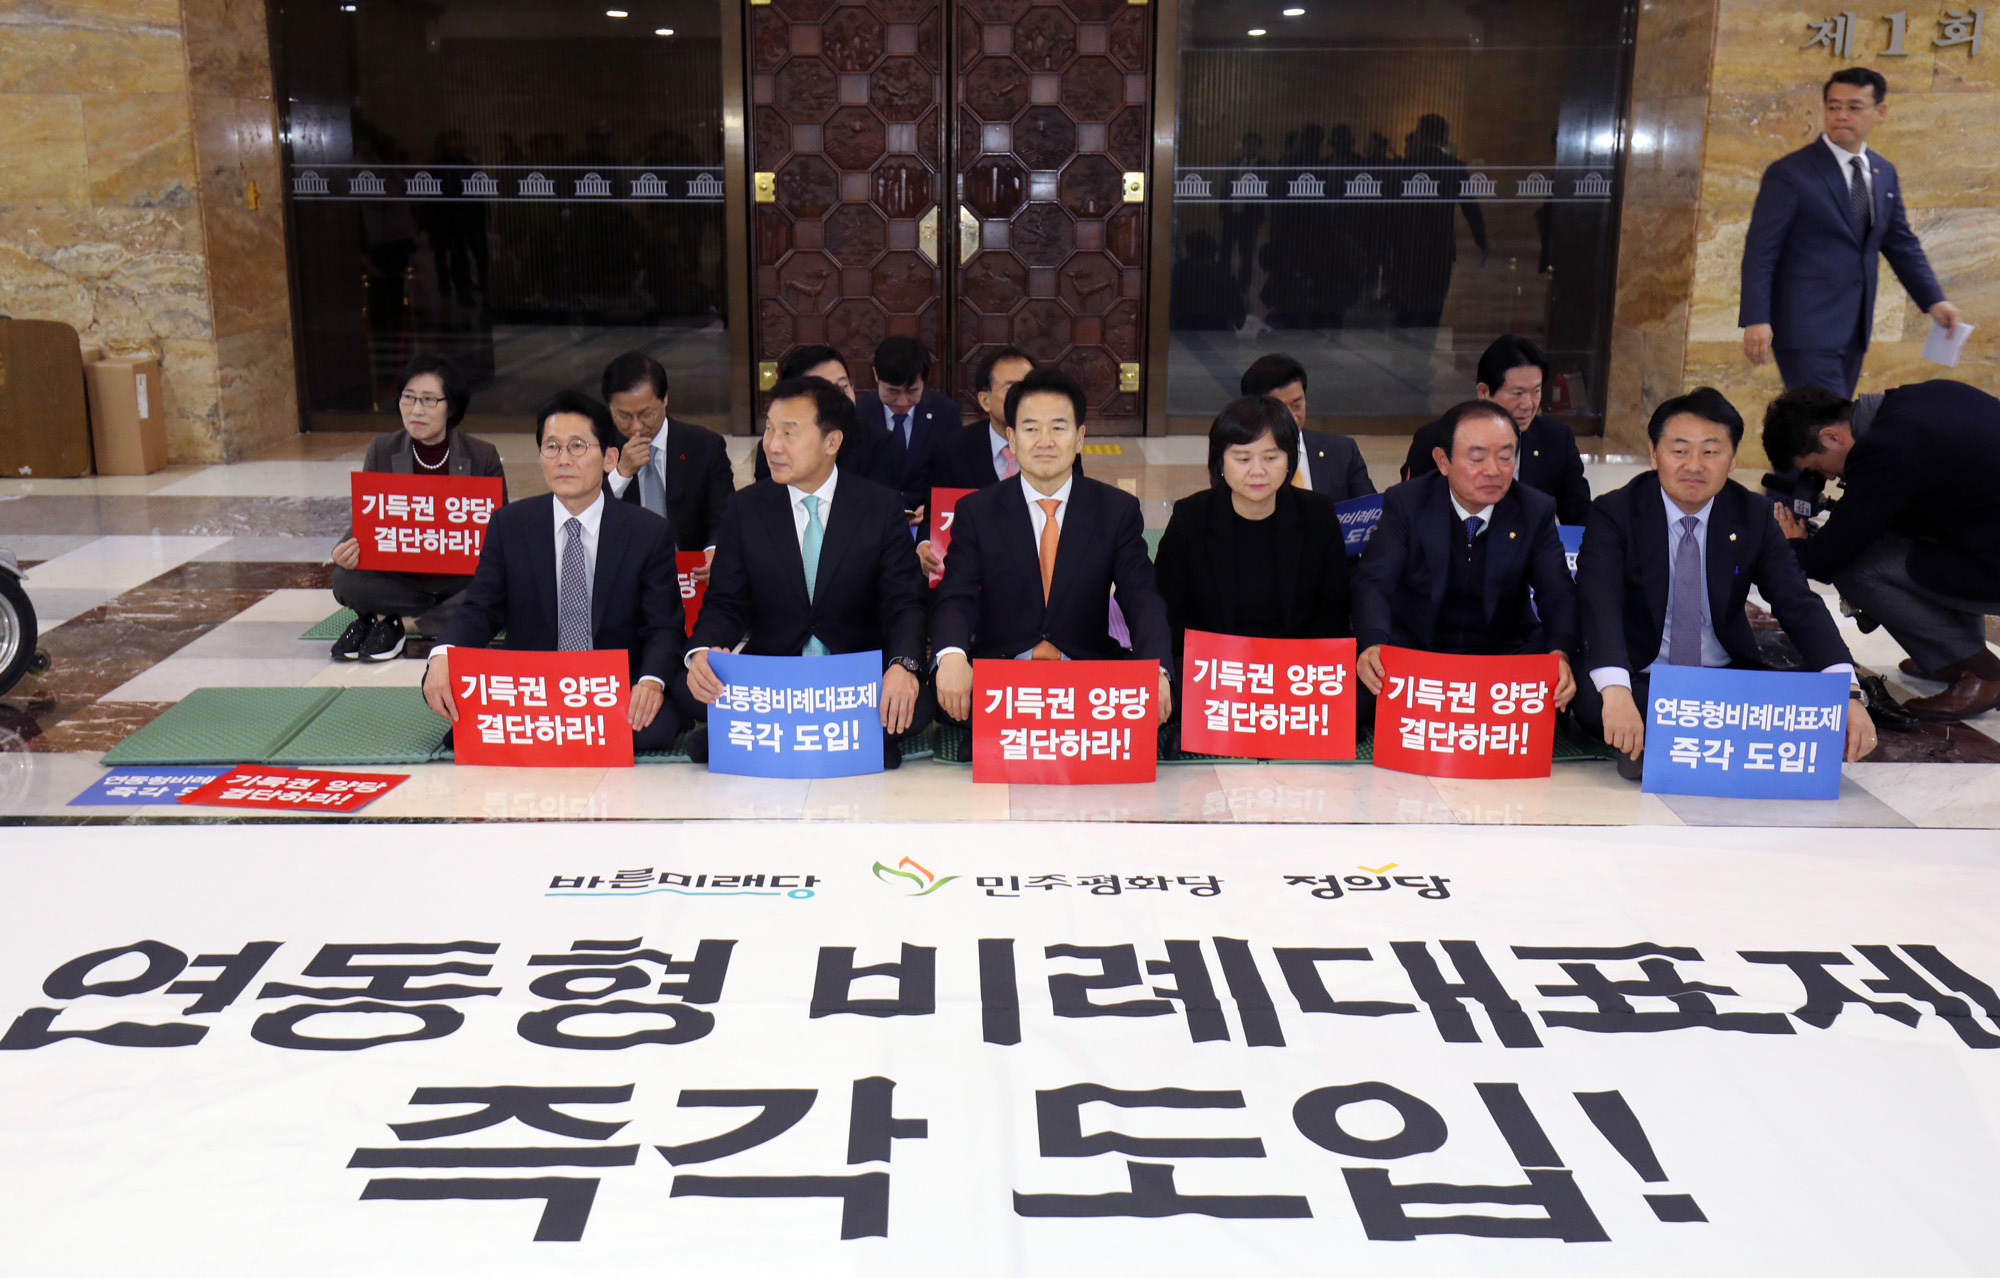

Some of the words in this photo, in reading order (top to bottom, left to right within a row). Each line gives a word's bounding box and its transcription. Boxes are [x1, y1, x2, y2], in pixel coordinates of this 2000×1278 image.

[363, 494, 434, 520] 기득권
[446, 498, 494, 523] 양당
[375, 527, 480, 555] 결단하라!
[462, 675, 547, 706] 기득권
[560, 676, 619, 707] 양당
[1193, 659, 1273, 693] 기득권
[1287, 665, 1346, 695] 양당
[985, 687, 1074, 719] 기득권
[1089, 687, 1149, 719] 양당
[1388, 677, 1476, 713] 기득권
[1491, 682, 1548, 714] 양당
[478, 714, 605, 744] 결단하라!
[1204, 700, 1328, 735] 결단하라!
[1655, 698, 1841, 731] 연동형비례대표제
[729, 721, 783, 752] 즉각
[794, 720, 859, 751] 도입!
[1000, 728, 1130, 760] 결단하라!
[1399, 718, 1528, 754] 결단하라!
[1670, 737, 1734, 770] 즉각
[1744, 742, 1817, 772] 도입!
[106, 786, 169, 797] 즉각
[219, 787, 354, 805] 결단하라!
[225, 774, 320, 791] 기득권
[324, 780, 388, 794] 양당
[548, 867, 820, 899] 바른미래당
[977, 875, 1221, 896] 민주평화당
[1284, 873, 1450, 899] 정의당
[0, 937, 738, 1050] 연동형
[810, 937, 2000, 1048] 비례대표제
[347, 1077, 927, 1241] 즉각
[1013, 1082, 1708, 1242] 도입!
